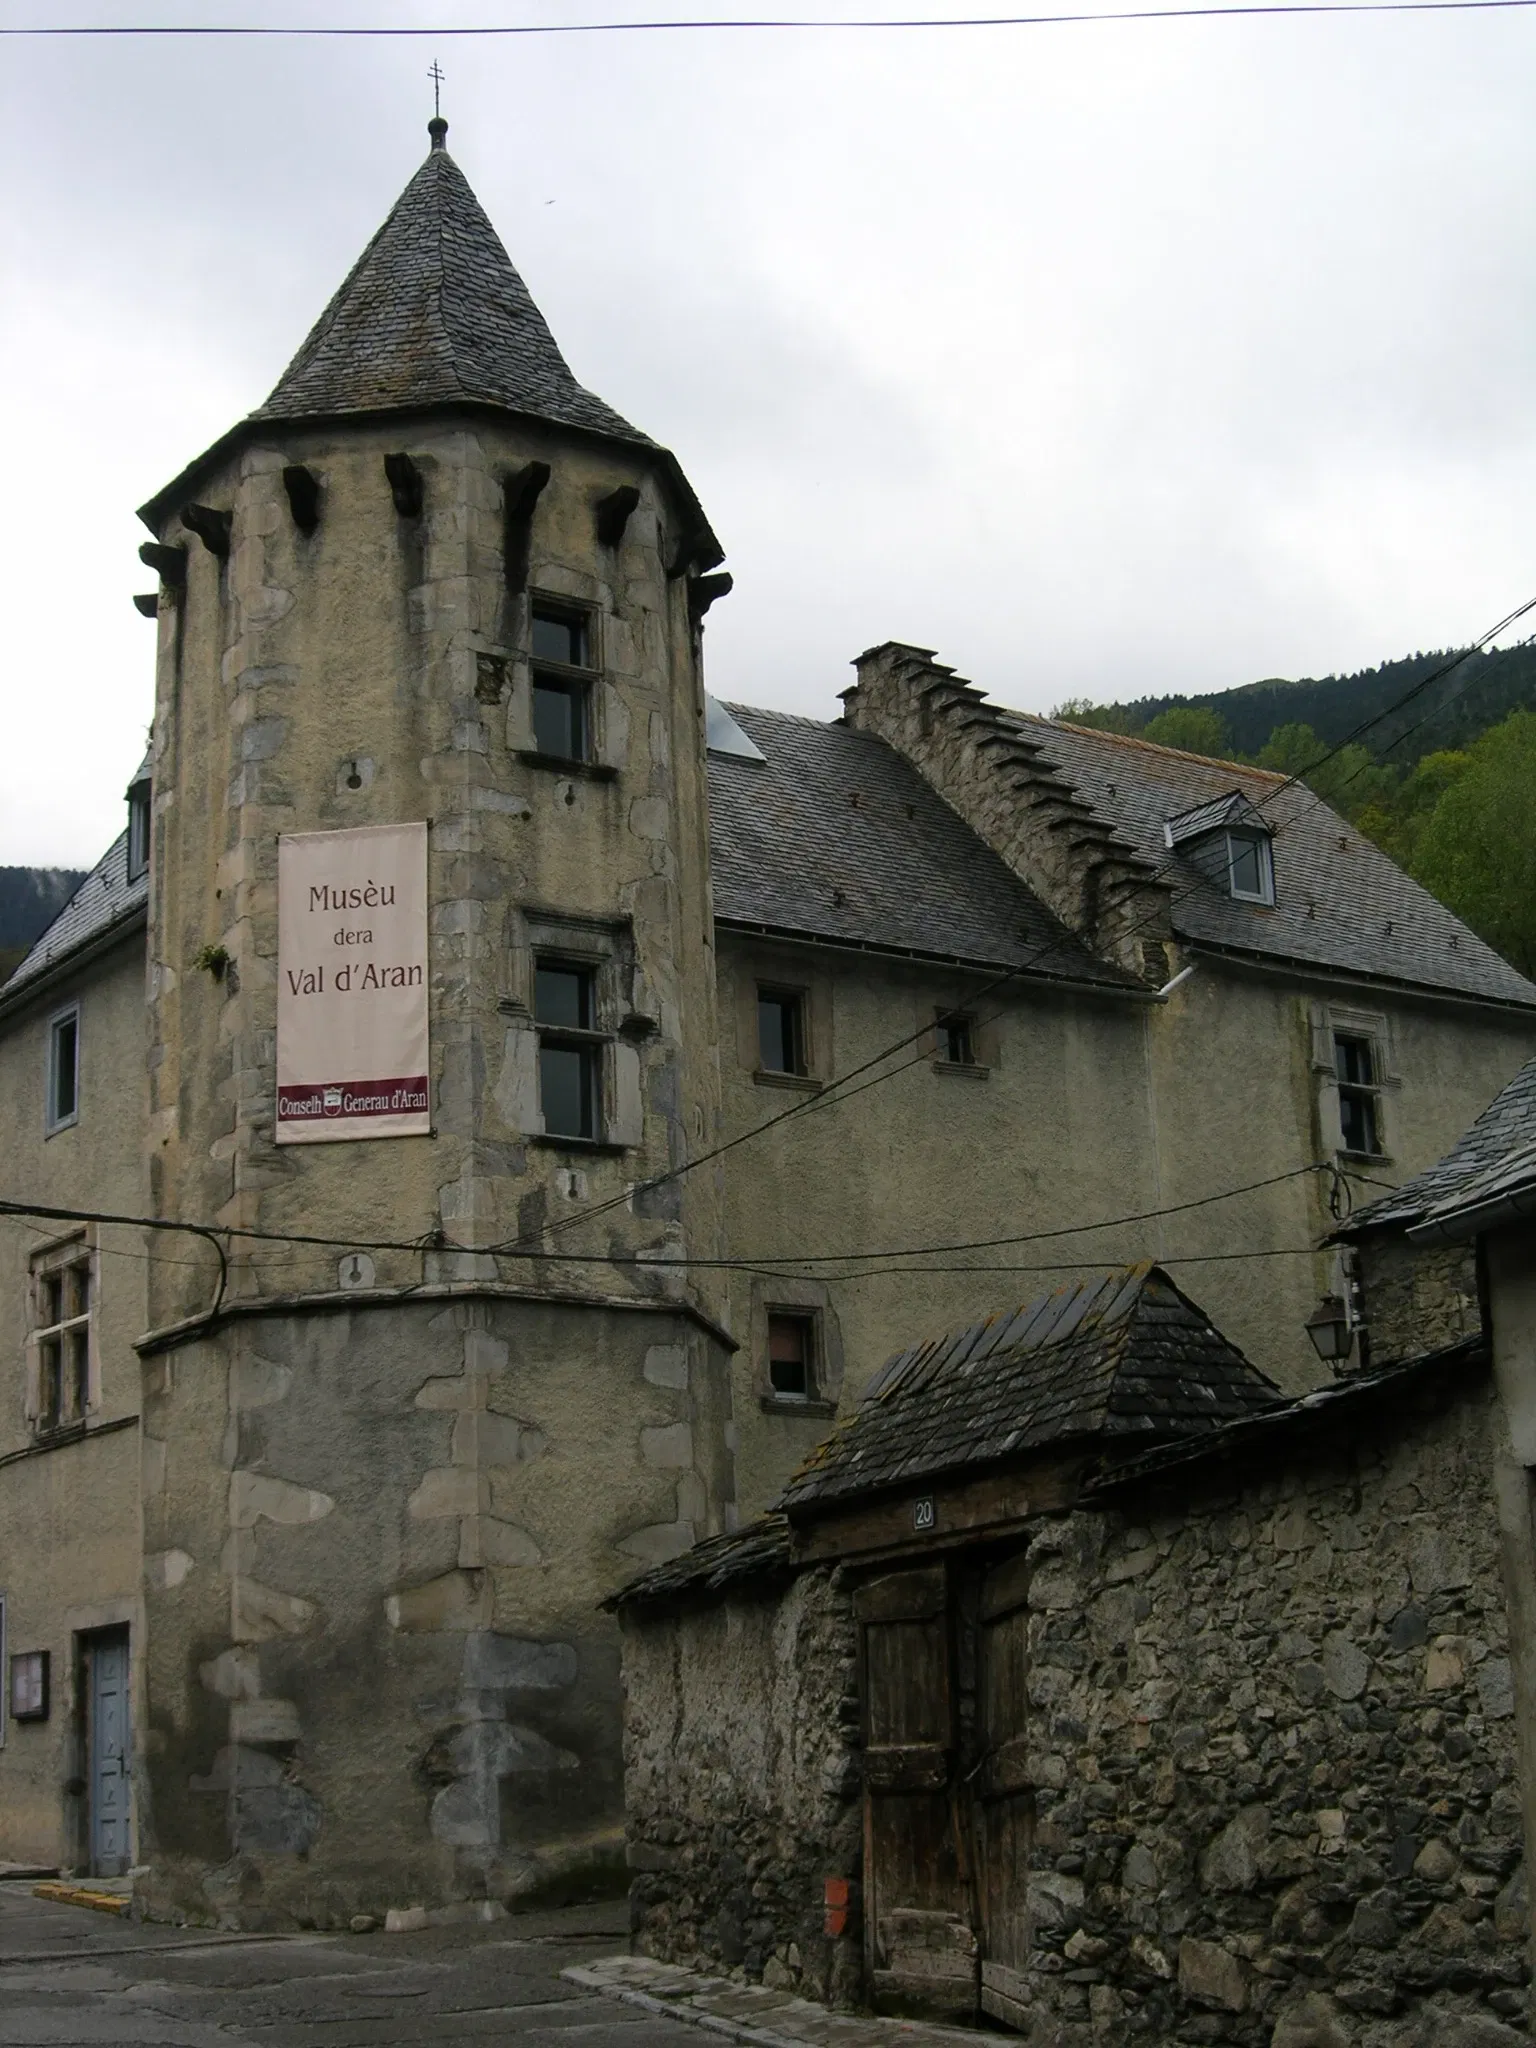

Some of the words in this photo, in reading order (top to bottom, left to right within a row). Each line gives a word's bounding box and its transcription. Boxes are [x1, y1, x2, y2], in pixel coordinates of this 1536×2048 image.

[309, 880, 396, 912] Musèu
[334, 928, 373, 945] dera
[287, 966, 324, 996] Val
[335, 963, 423, 991] d'Aran
[279, 1095, 322, 1116] Conselh
[343, 1093, 389, 1112] Generau
[391, 1089, 427, 1109] d'Aran
[916, 1501, 931, 1524] 20
